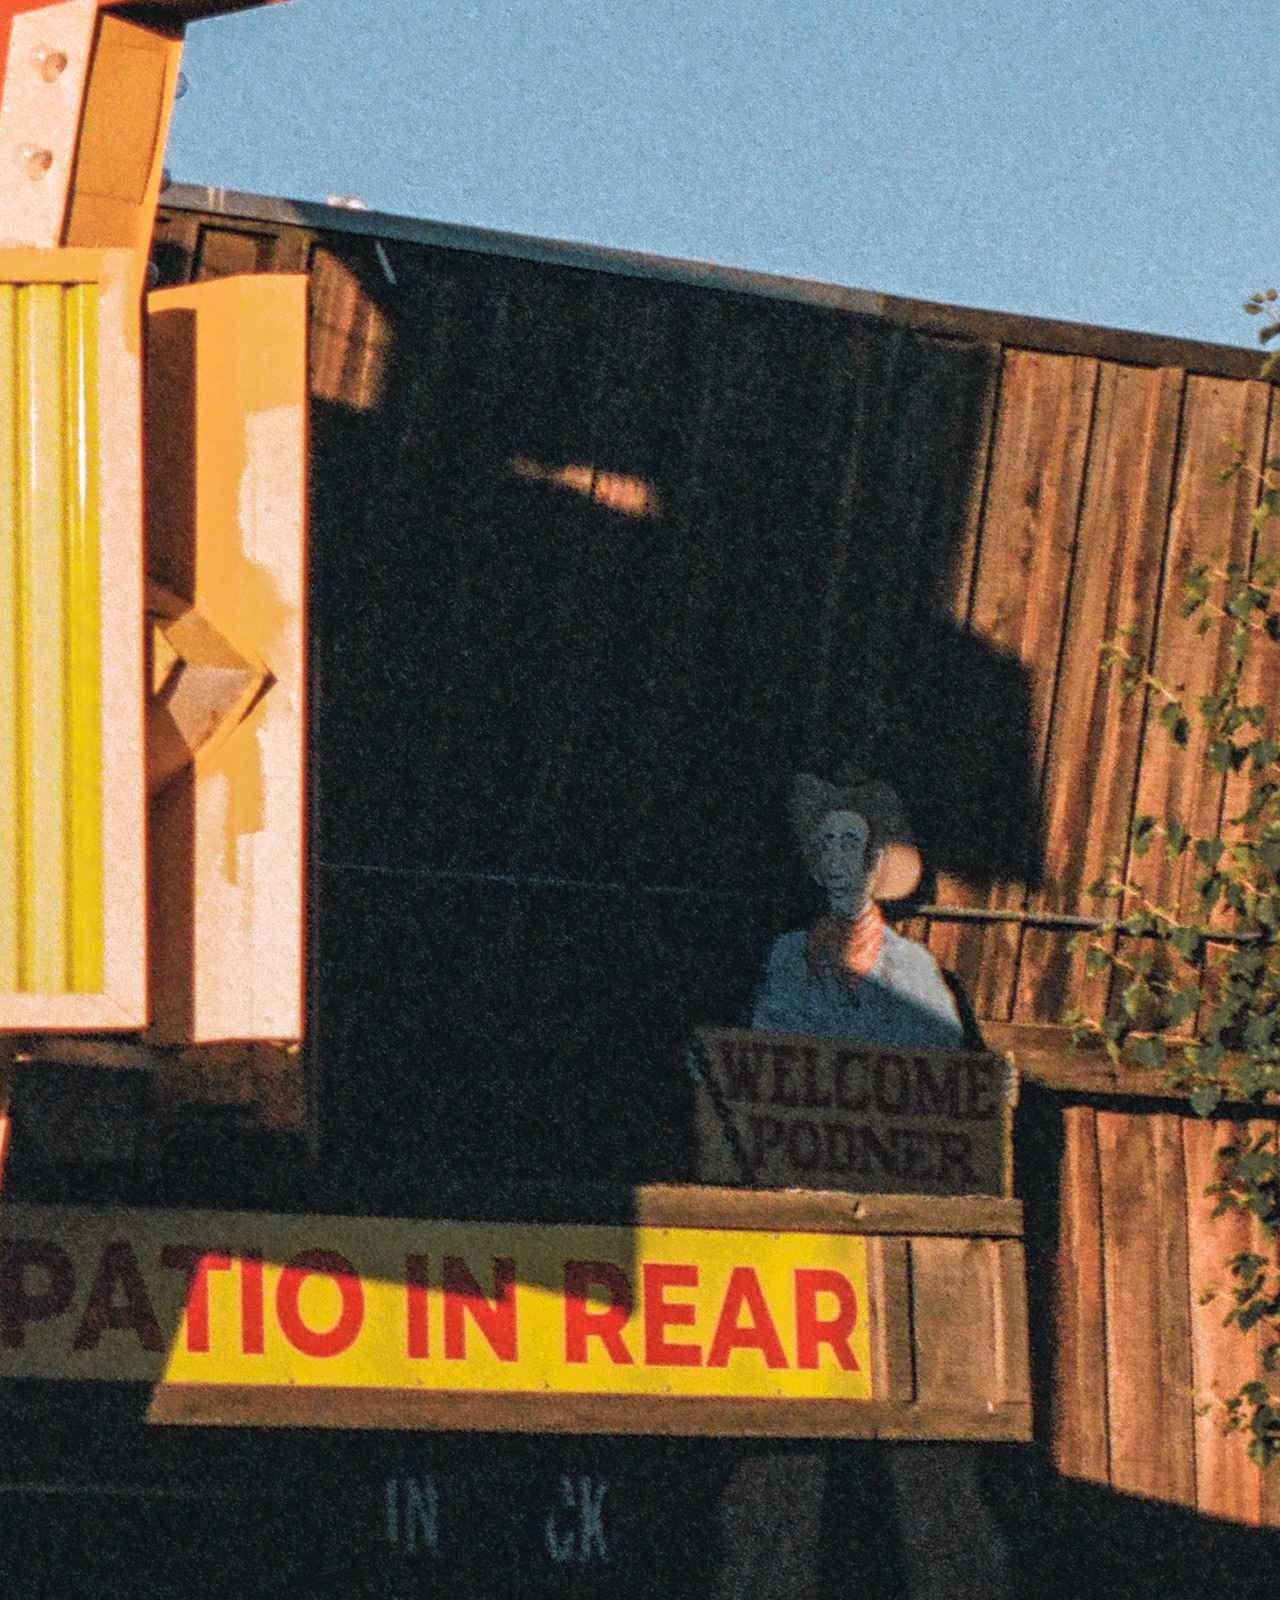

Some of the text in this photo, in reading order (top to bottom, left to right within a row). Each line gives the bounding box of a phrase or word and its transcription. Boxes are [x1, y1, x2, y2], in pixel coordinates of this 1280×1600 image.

[718, 1040, 997, 1121] WELCOME
[748, 1114, 980, 1183] PODNER
[405, 1253, 518, 1363] IN
[562, 1261, 860, 1373] REAR
